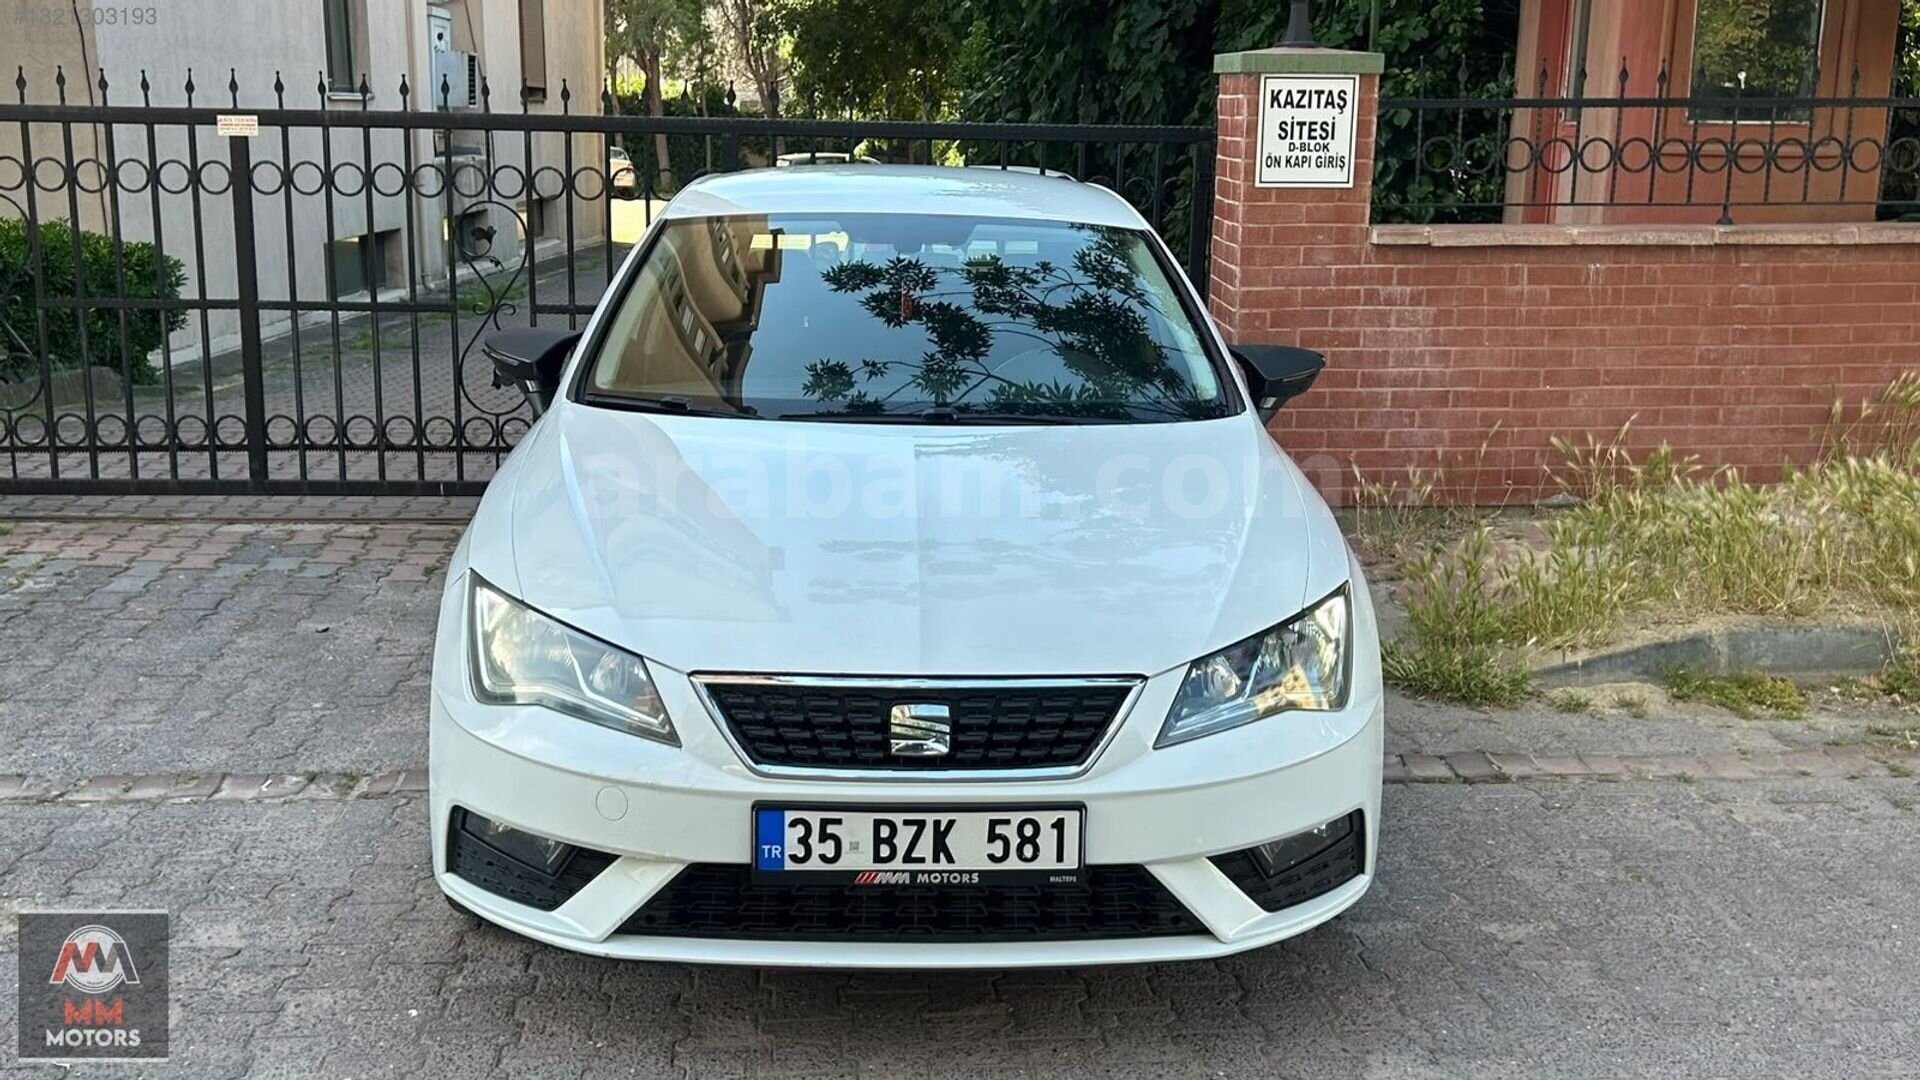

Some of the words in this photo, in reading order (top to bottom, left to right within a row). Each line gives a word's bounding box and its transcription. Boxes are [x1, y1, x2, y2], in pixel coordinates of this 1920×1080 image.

[1270, 89, 1348, 115] KAZITAŞ
[1278, 116, 1336, 140] SİTESİ
[1288, 142, 1330, 152] D-BLOK
[1265, 152, 1281, 168] ÖN
[1285, 155, 1311, 168] KAPI
[1315, 152, 1346, 172] GİRİŞ
[761, 845, 782, 859] TR
[788, 817, 843, 864] 35
[872, 818, 957, 864] BZK
[986, 817, 1065, 863] 581
[916, 872, 979, 884] MOTORS
